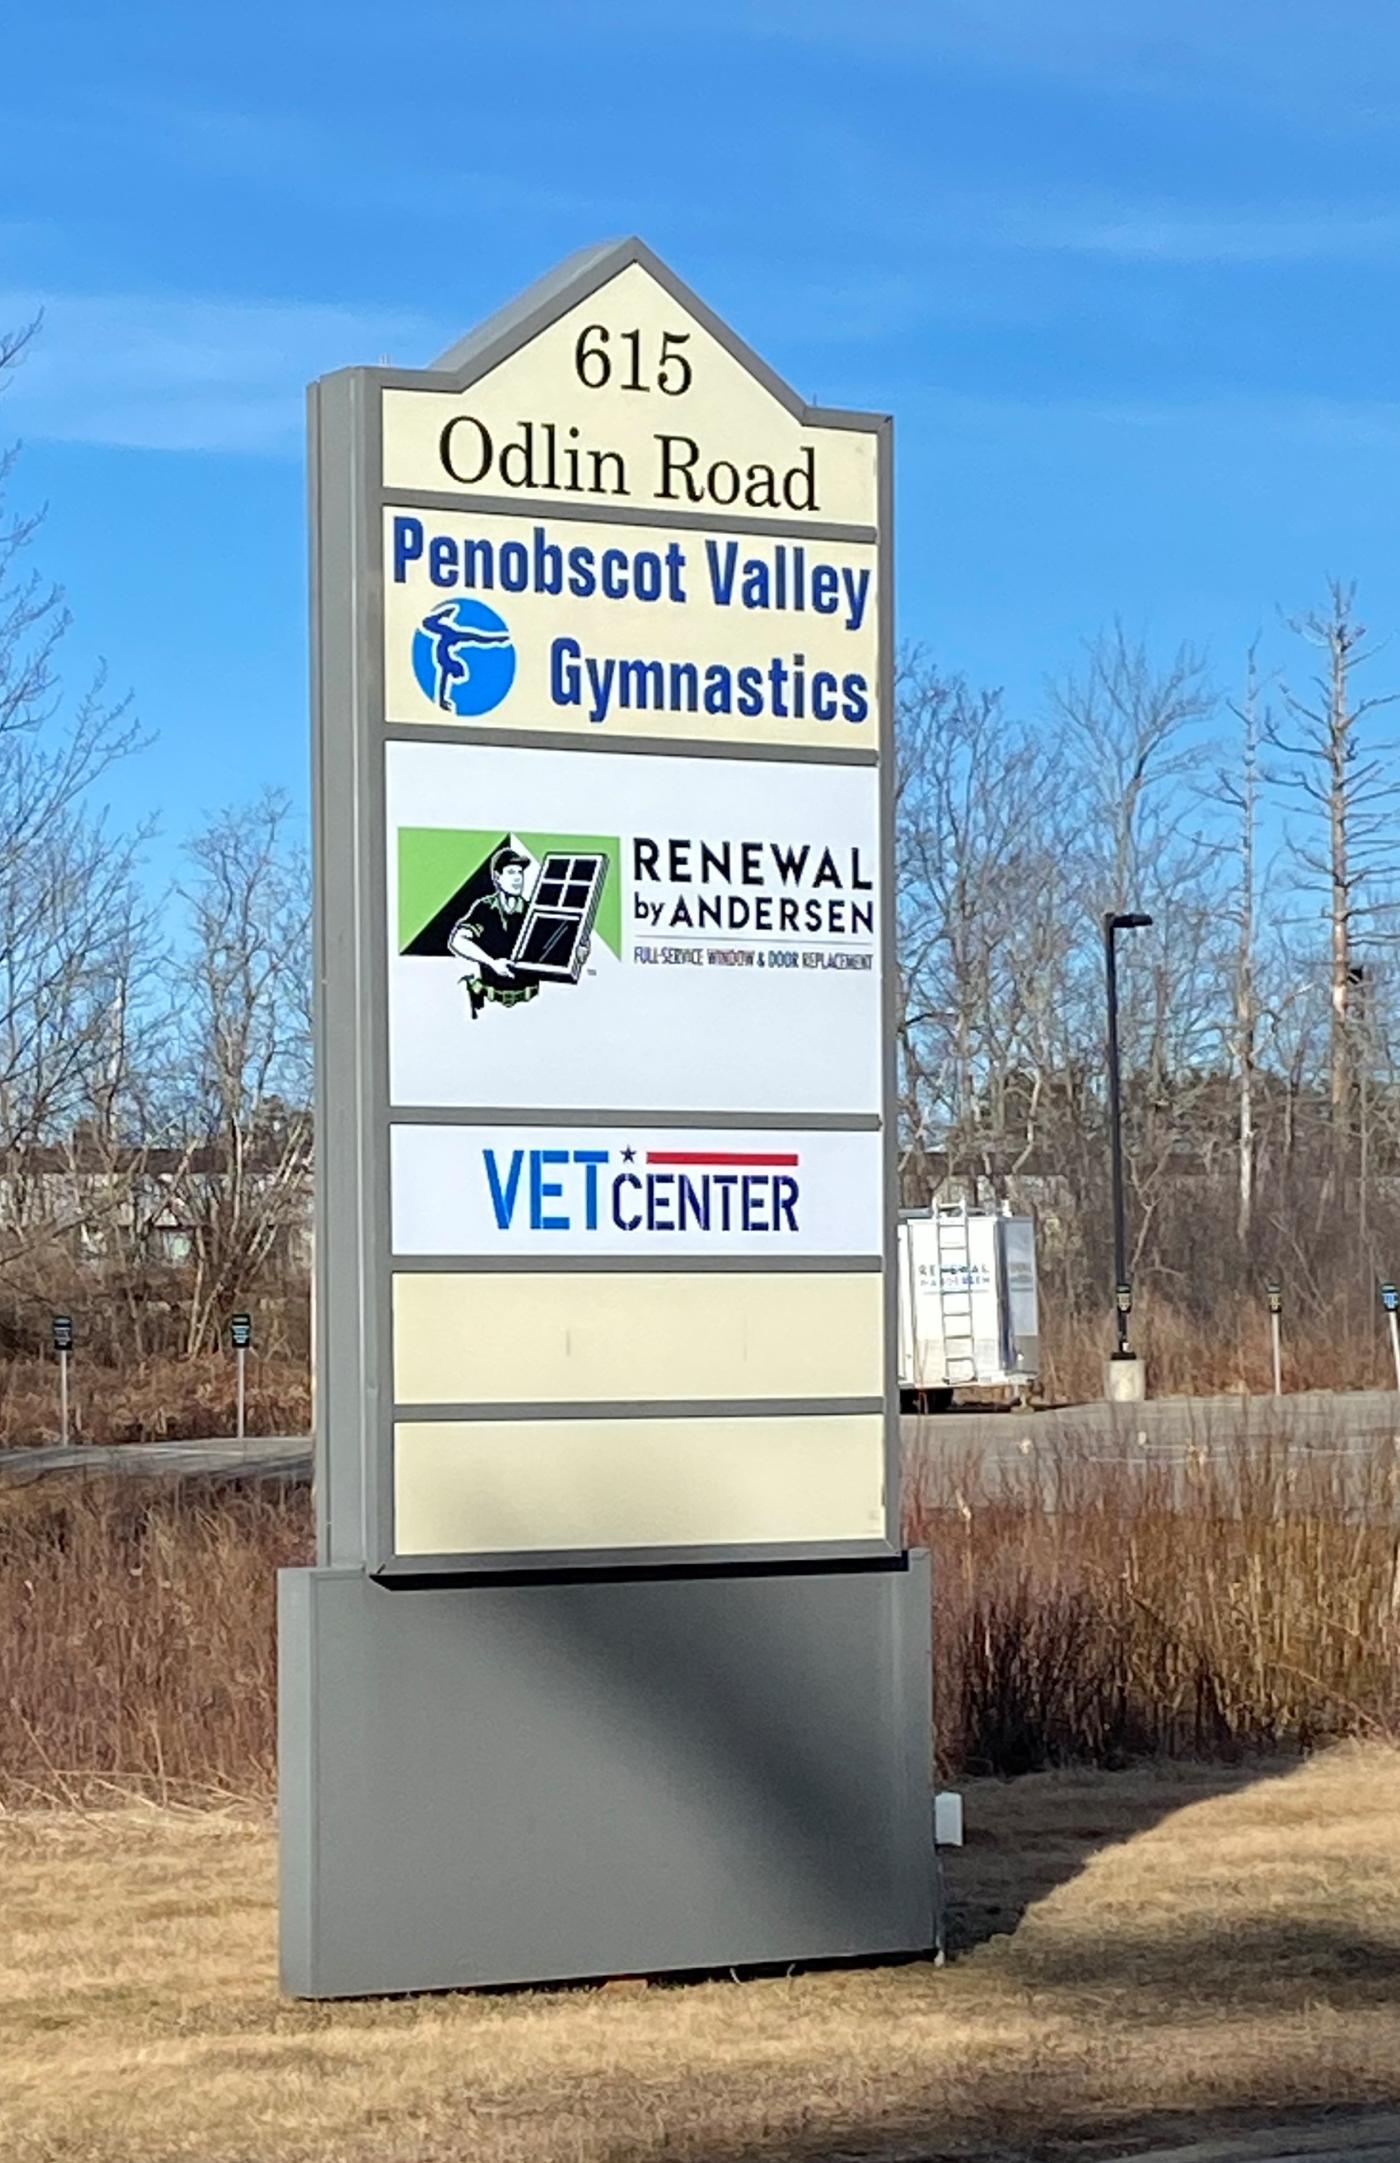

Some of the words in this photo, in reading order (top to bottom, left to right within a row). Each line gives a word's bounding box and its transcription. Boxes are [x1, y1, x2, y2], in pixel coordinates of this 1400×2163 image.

[575, 325, 693, 396] 615
[439, 416, 631, 497] Odlin
[653, 434, 820, 511] Road
[393, 516, 687, 603] Penobscot
[705, 538, 871, 631] Valley
[550, 637, 869, 724] Gymnastics
[633, 837, 873, 890] RENEWAL
[634, 891, 665, 926] by
[669, 894, 873, 934] ANDERSEN
[633, 946, 703, 966] FULL-SERVICE
[707, 948, 755, 967] WINDOW
[756, 950, 765, 968] &
[768, 950, 799, 968] DOOR
[802, 952, 873, 970] REPLACEMENT
[482, 1149, 609, 1230] VET
[612, 1173, 799, 1232] CENTER
